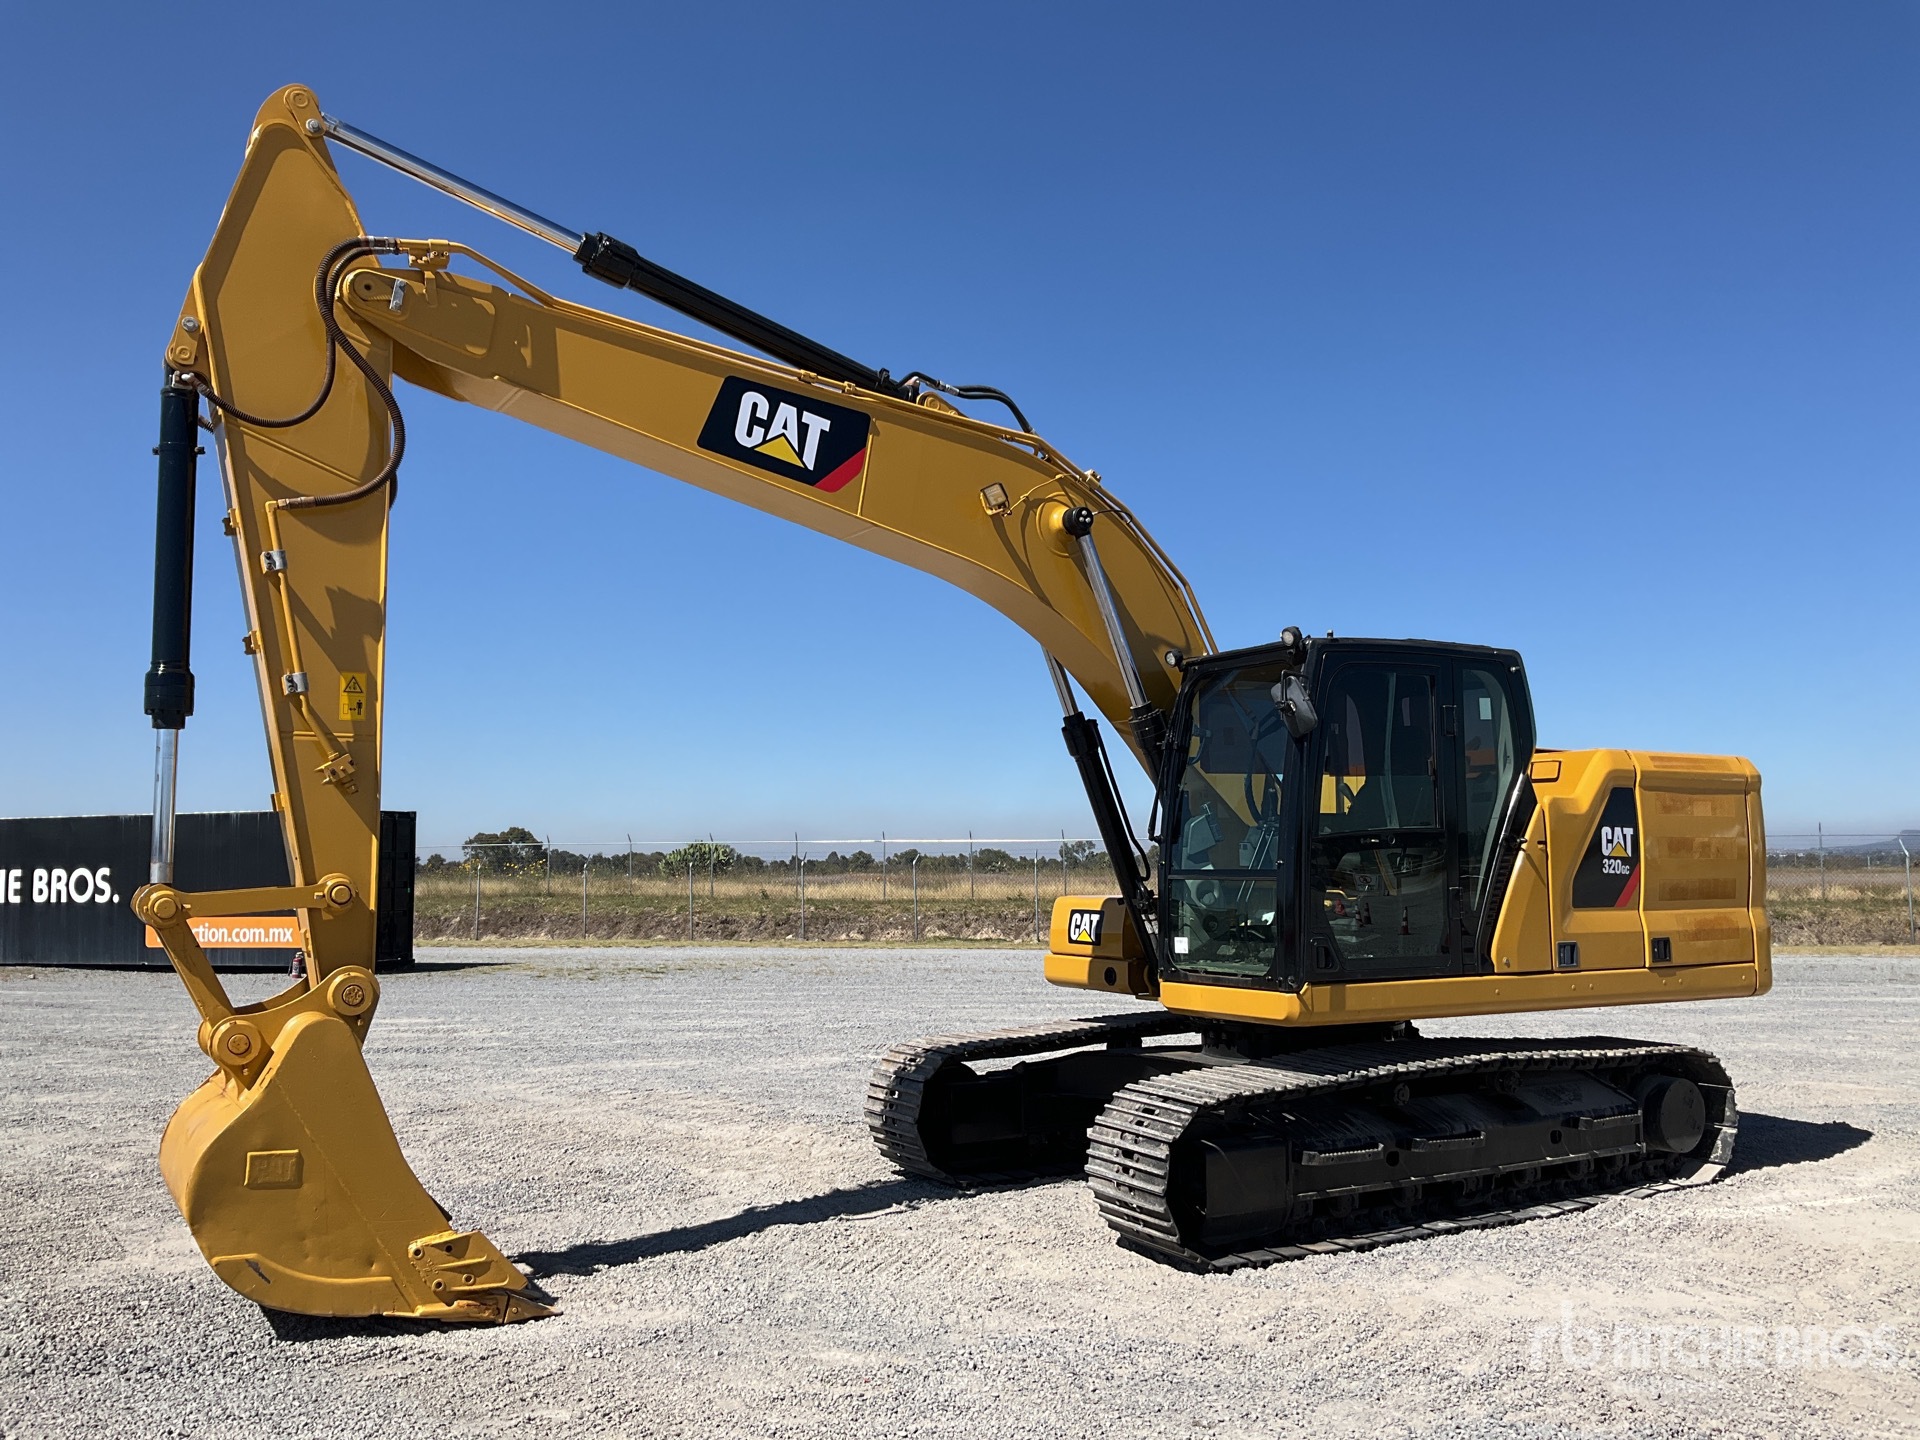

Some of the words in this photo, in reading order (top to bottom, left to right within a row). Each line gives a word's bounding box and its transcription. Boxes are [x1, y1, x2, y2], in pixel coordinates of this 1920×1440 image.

[735, 391, 831, 471] CAT
[1601, 826, 1634, 857] CAT
[32, 867, 120, 904] BROS.
[1070, 912, 1100, 942] CAT
